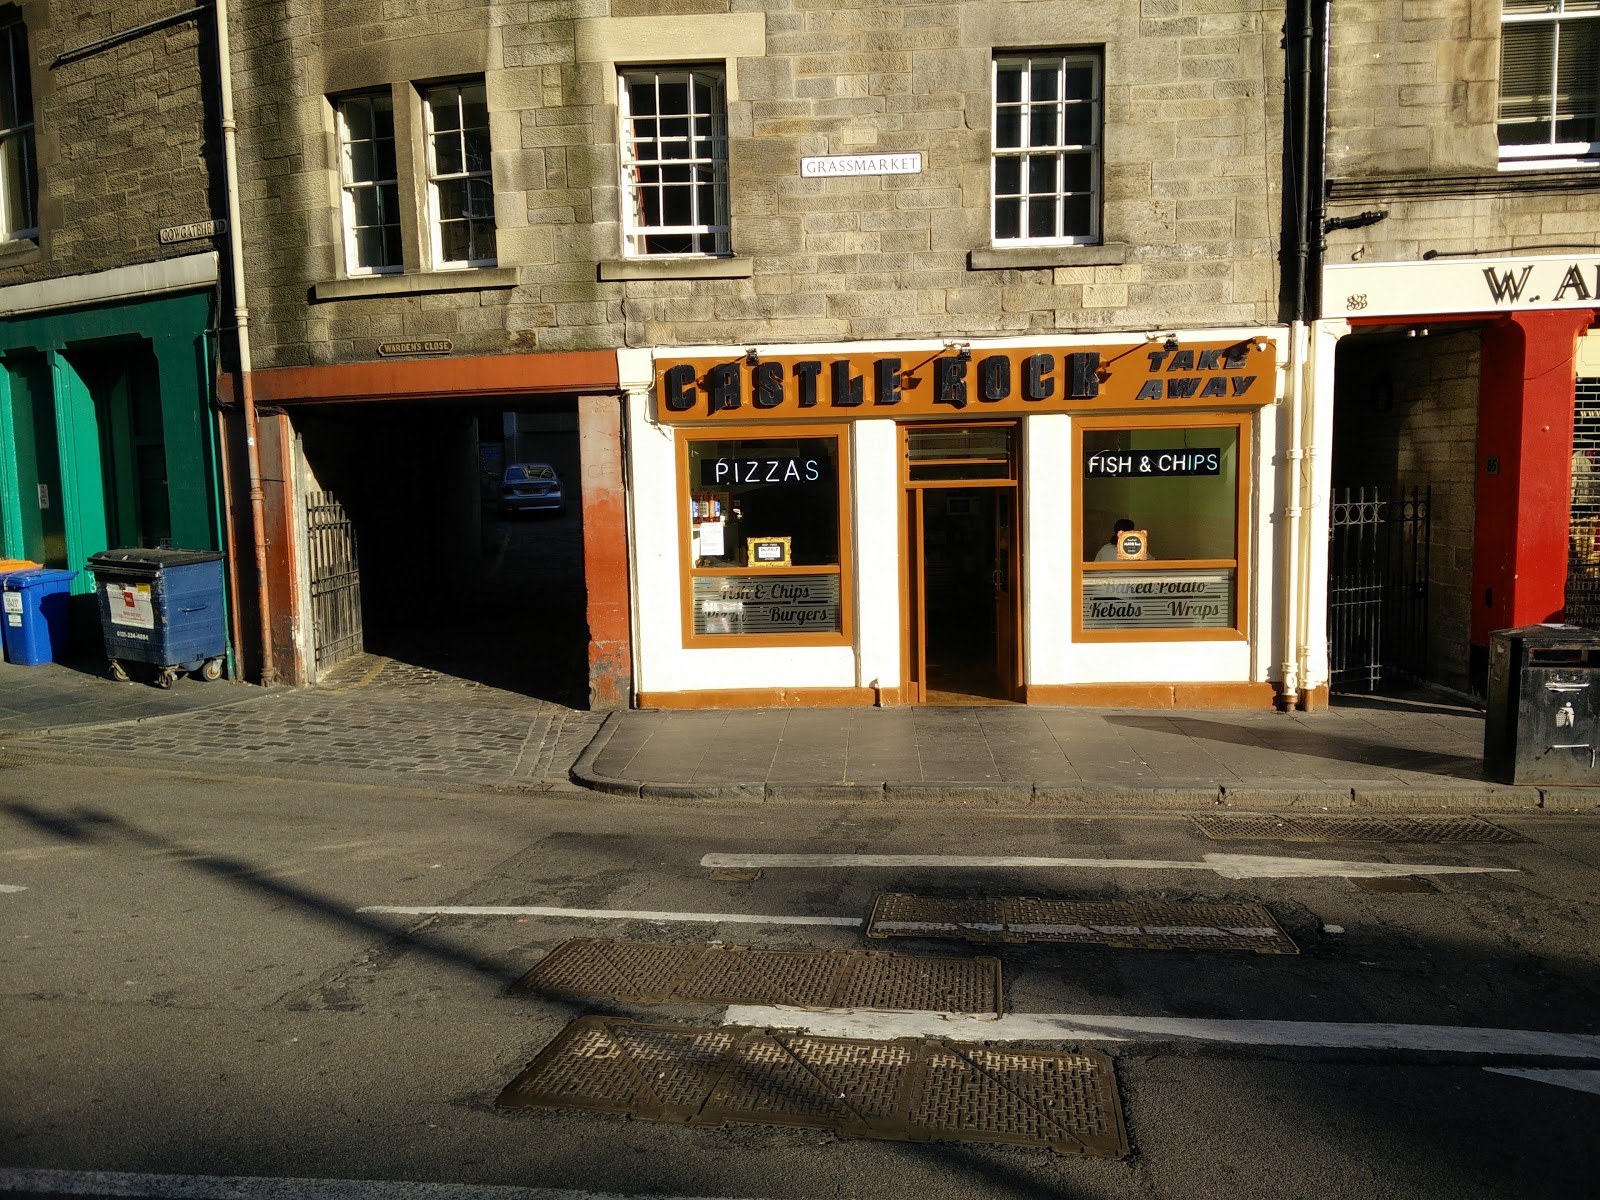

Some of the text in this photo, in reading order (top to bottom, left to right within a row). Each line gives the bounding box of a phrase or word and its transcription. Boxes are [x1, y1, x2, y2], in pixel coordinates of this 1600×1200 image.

[806, 157, 918, 173] GRASSMARKET
[161, 220, 225, 241] COWGATEHEAD
[424, 341, 449, 351] CLOSE
[1148, 349, 1249, 372] TAKE
[668, 352, 1101, 412] CASTLE ROCK
[1136, 375, 1257, 400] AWAY
[715, 459, 819, 483] PIZZAS
[1089, 453, 1218, 473] FISH & CHIPS
[754, 584, 767, 599] &
[771, 583, 811, 601] Chips
[769, 606, 828, 625] Burgers
[1089, 601, 1220, 620] Kebabs Wraps
